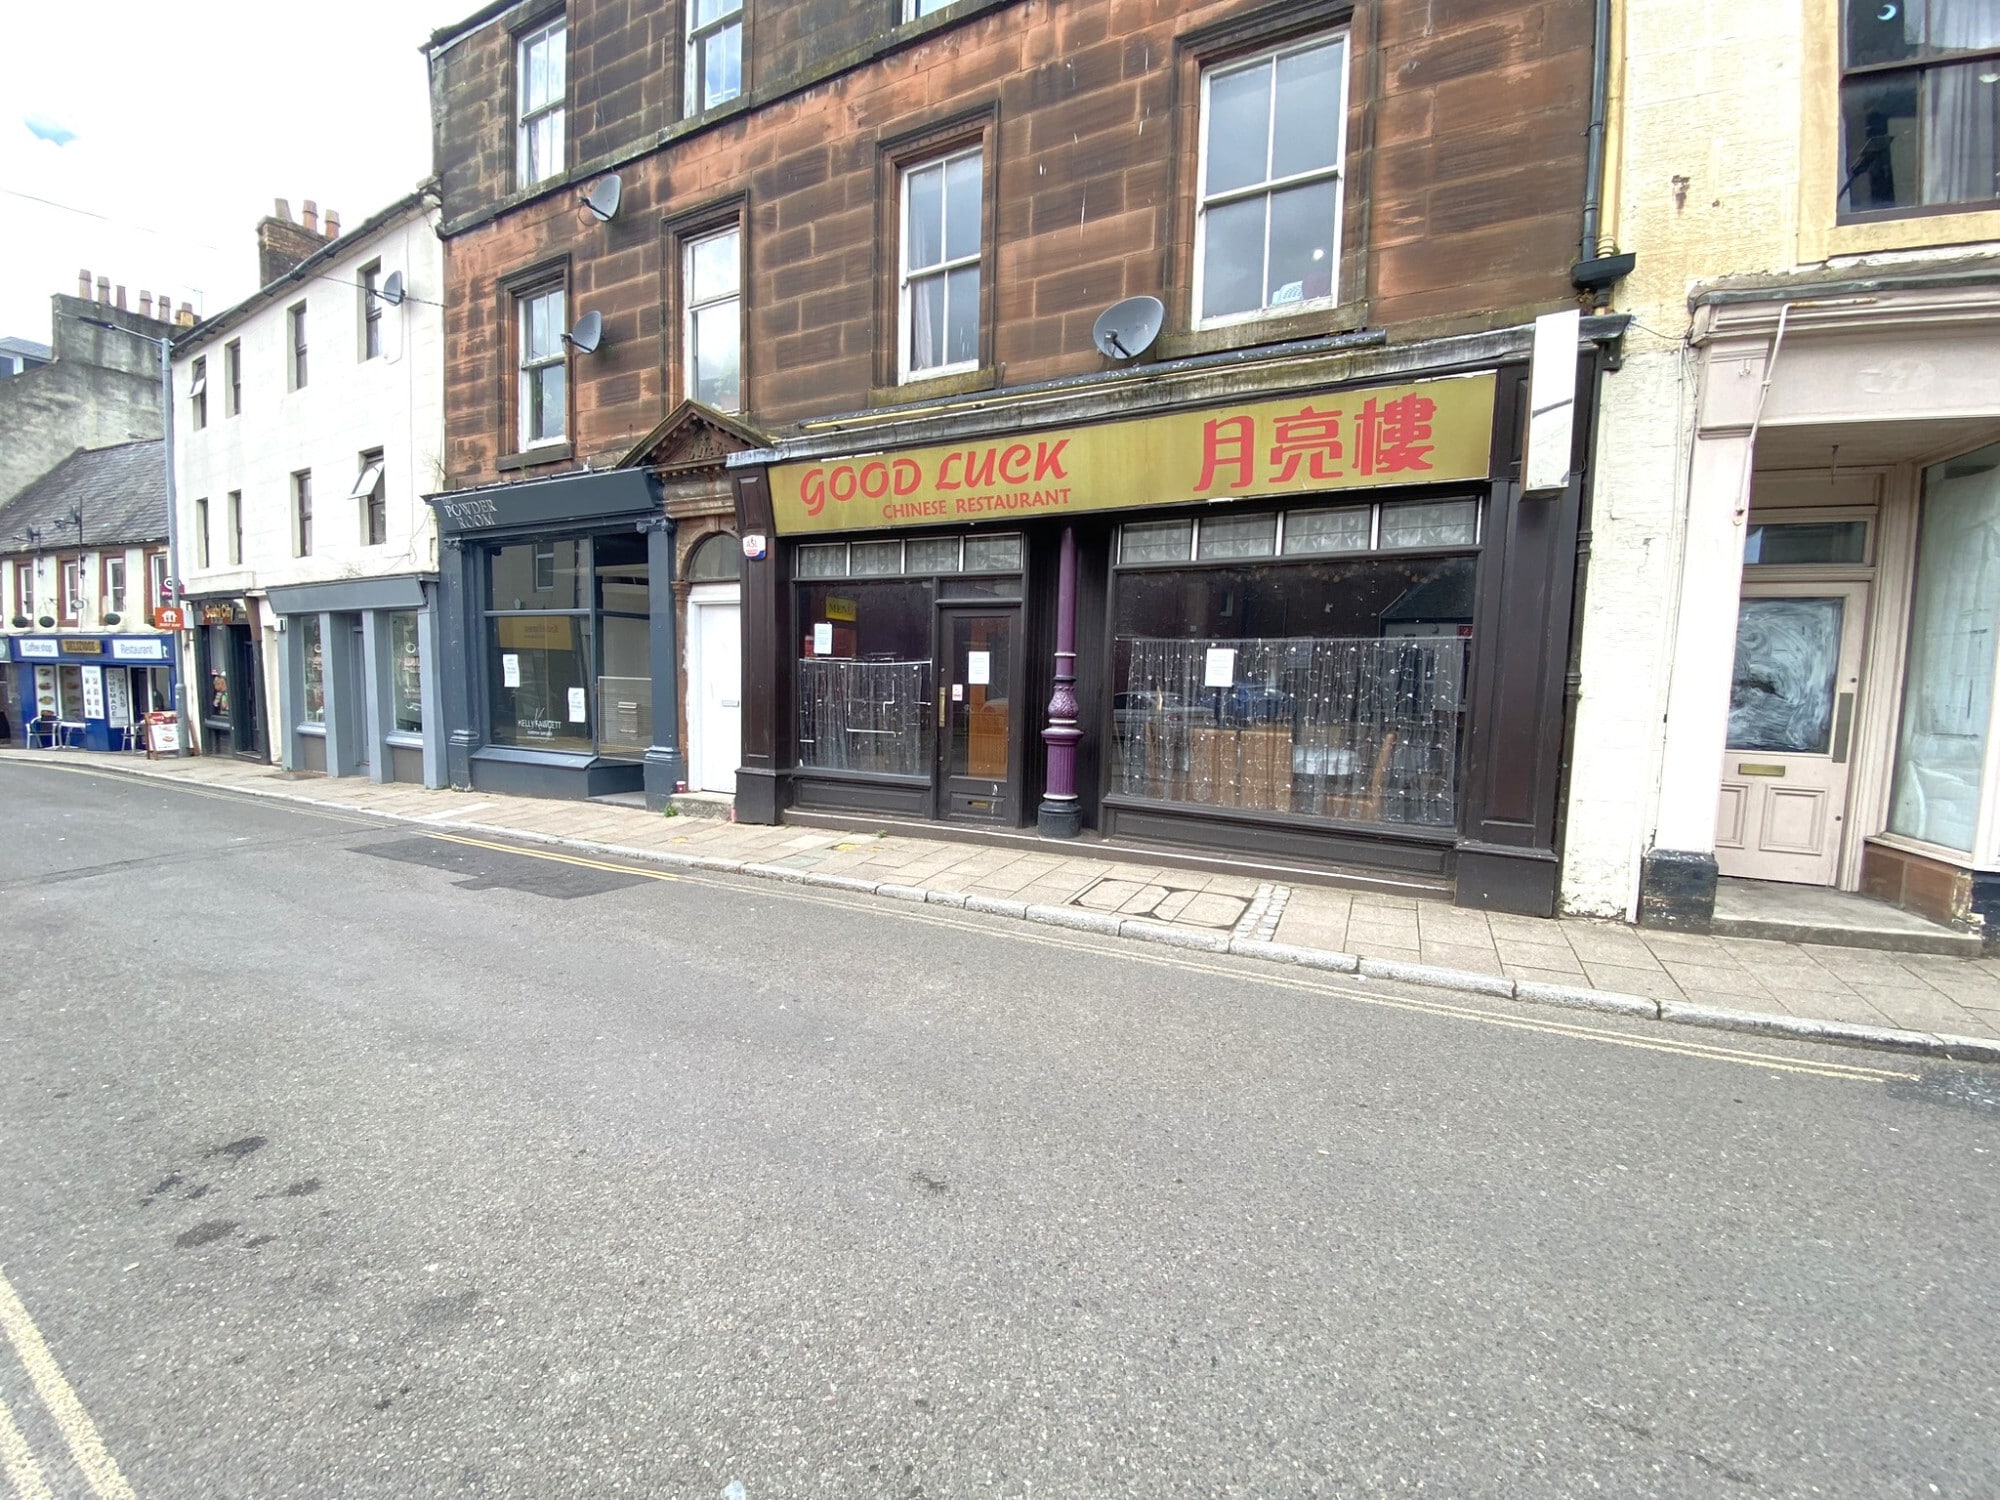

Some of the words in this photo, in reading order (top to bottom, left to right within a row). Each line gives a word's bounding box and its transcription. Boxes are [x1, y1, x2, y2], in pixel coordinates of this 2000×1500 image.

[1193, 392, 1437, 491] 月亮樓
[800, 458, 922, 516] GOOD
[935, 439, 1071, 491] LUCK
[444, 500, 498, 517] POWDER
[883, 500, 947, 519] CHINESE
[956, 488, 1072, 513] RESTAURANT
[456, 512, 496, 529] ROOM
[120, 643, 153, 655] Restaurant
[117, 677, 127, 708] MEALS
[518, 719, 534, 728] KELLY
